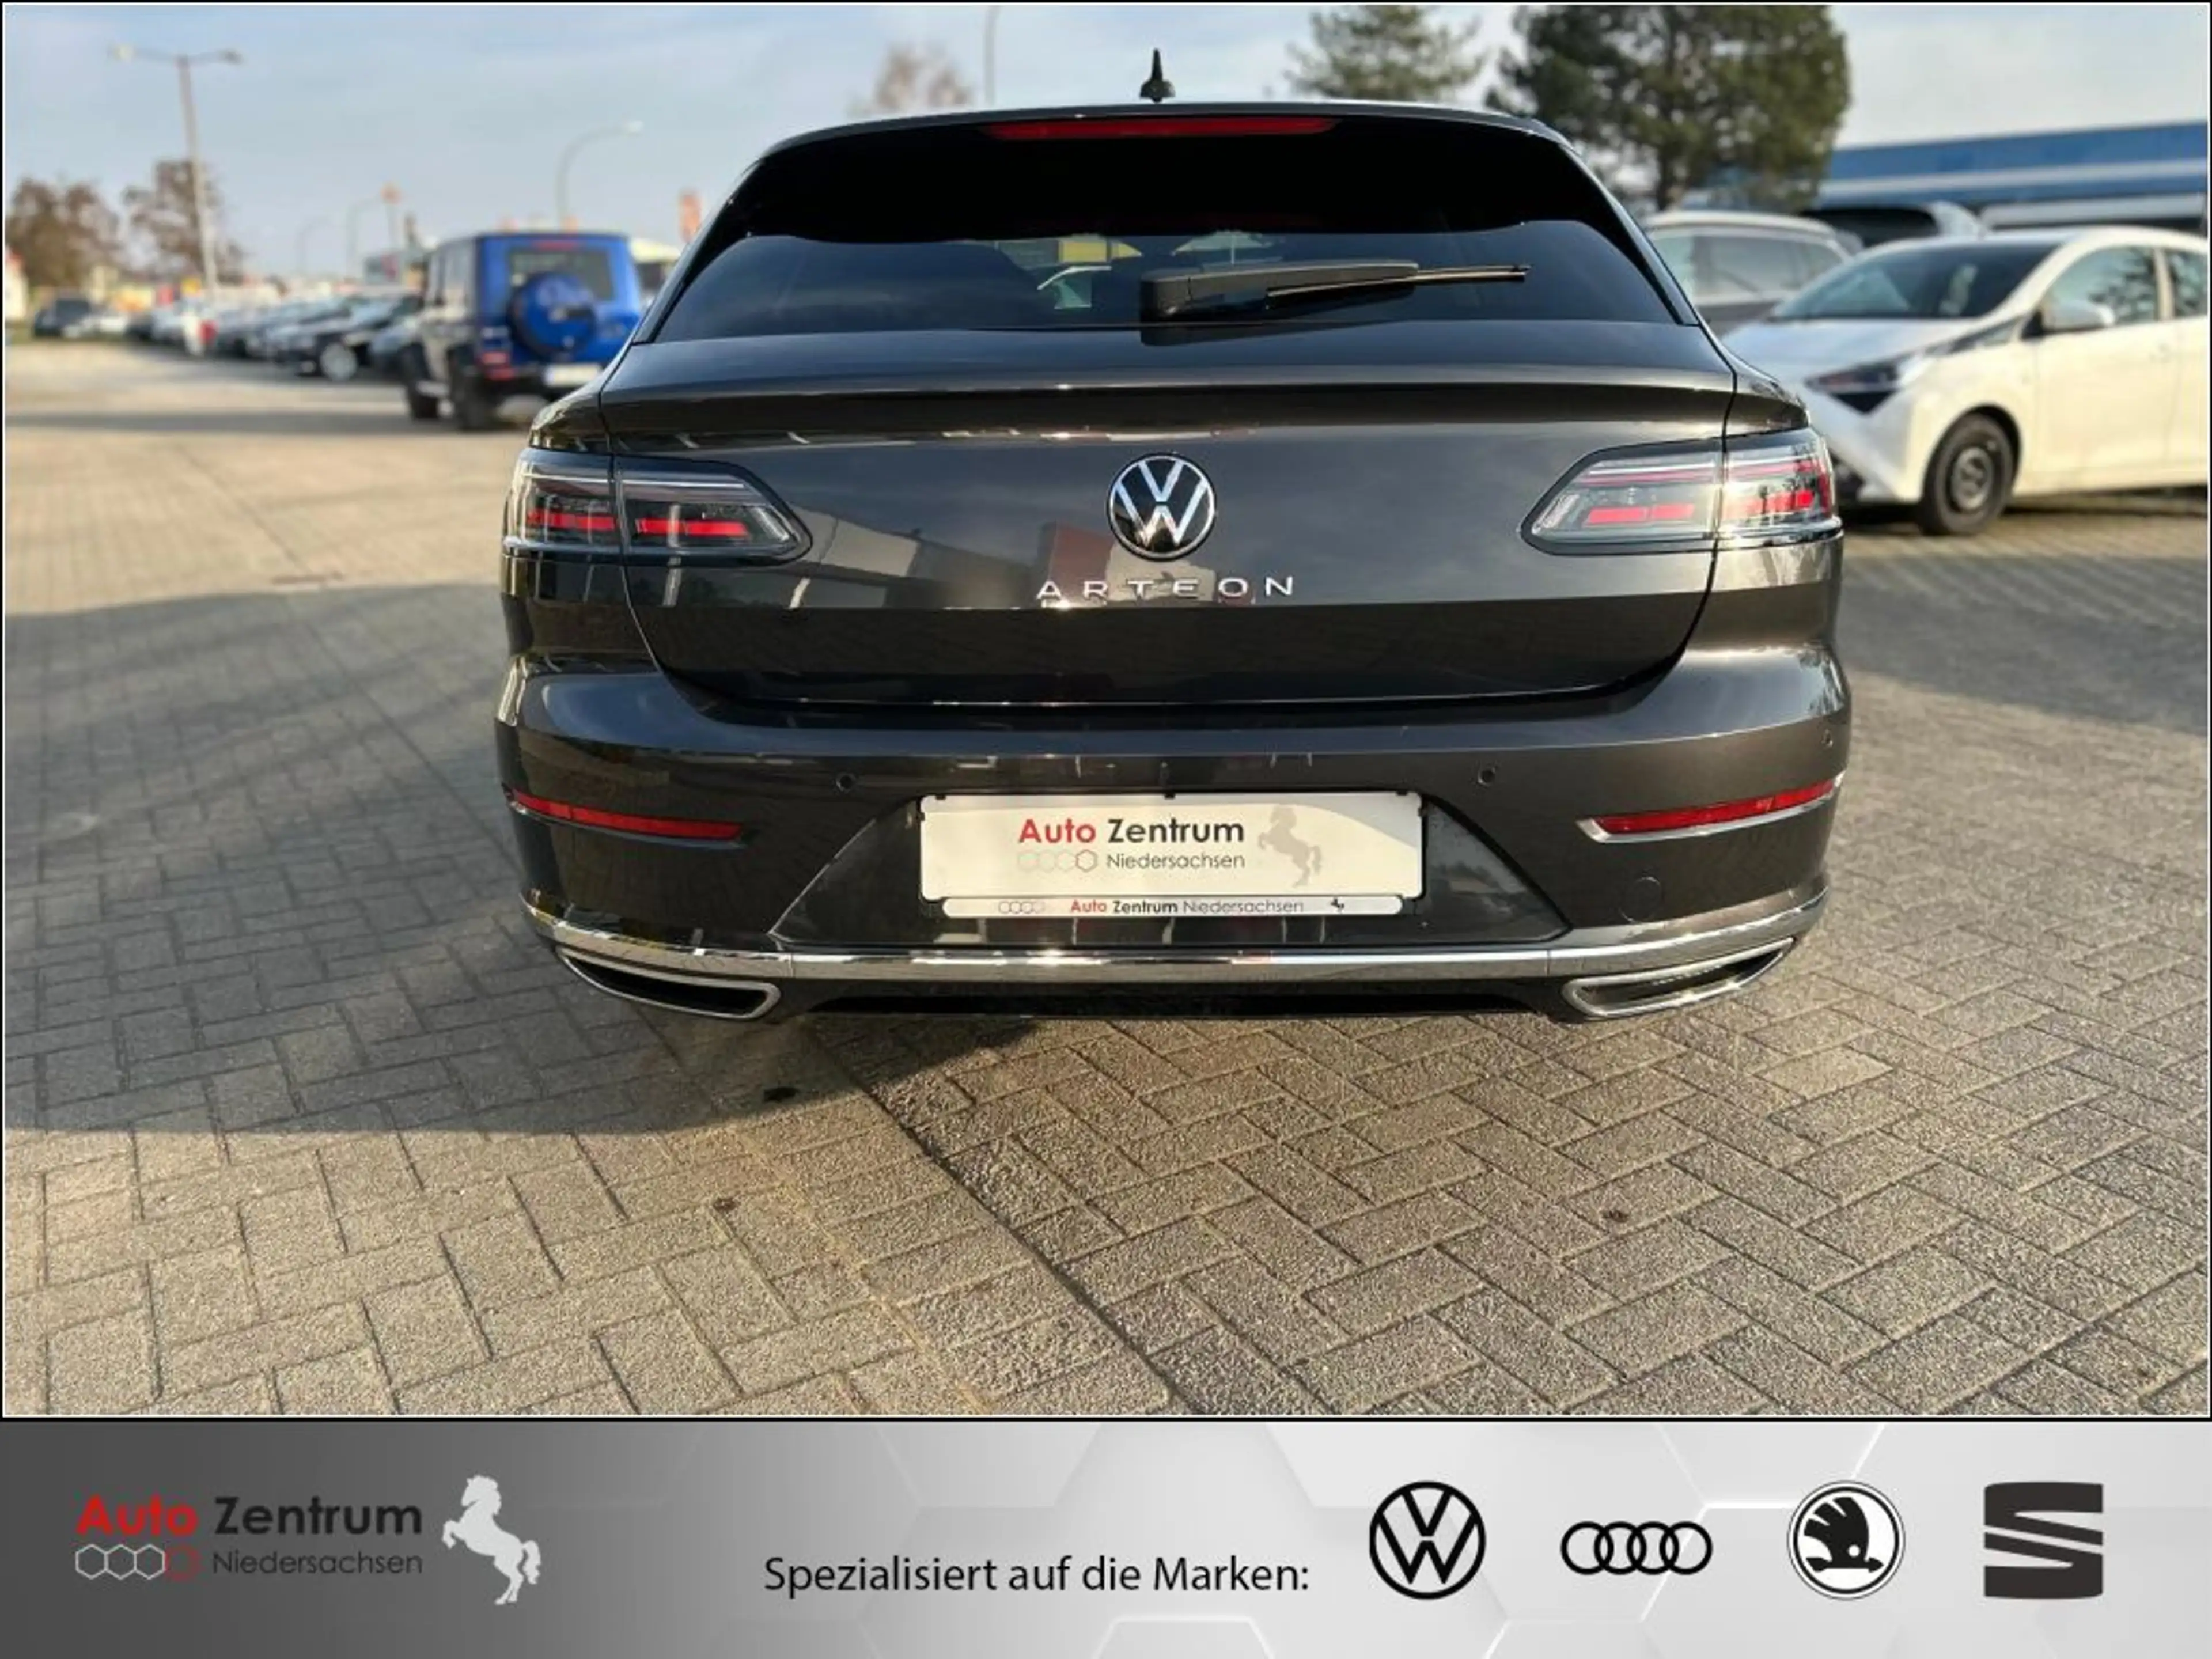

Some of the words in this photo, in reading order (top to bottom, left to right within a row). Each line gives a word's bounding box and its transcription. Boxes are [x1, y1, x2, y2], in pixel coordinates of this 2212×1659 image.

[1036, 576, 1294, 601] ARTEON
[1018, 818, 1097, 843] Auto
[1107, 818, 1245, 843] Zentrum
[1106, 853, 1245, 869] Niedersachsen
[1070, 899, 1108, 913] Auto
[1112, 900, 1179, 914] Zentrum
[1183, 899, 1304, 914] Niedersachsen
